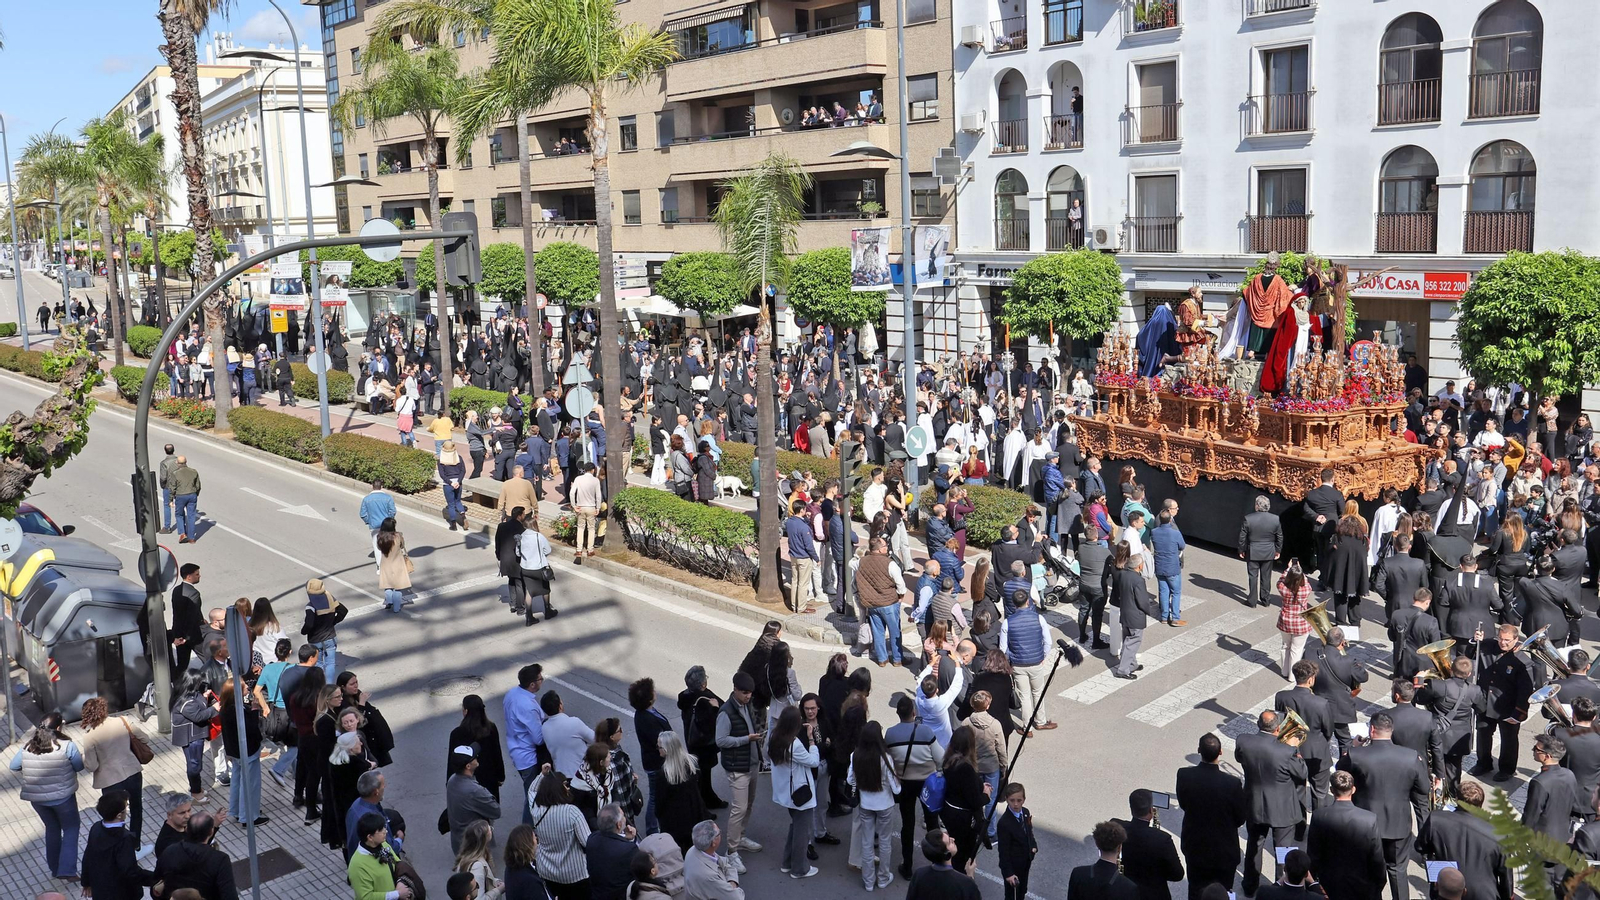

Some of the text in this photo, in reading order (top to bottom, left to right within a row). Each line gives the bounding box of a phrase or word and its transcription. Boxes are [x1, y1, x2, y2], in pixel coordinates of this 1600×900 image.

[1385, 276, 1420, 290] CASA
[1424, 281, 1466, 291] 956 322 200
